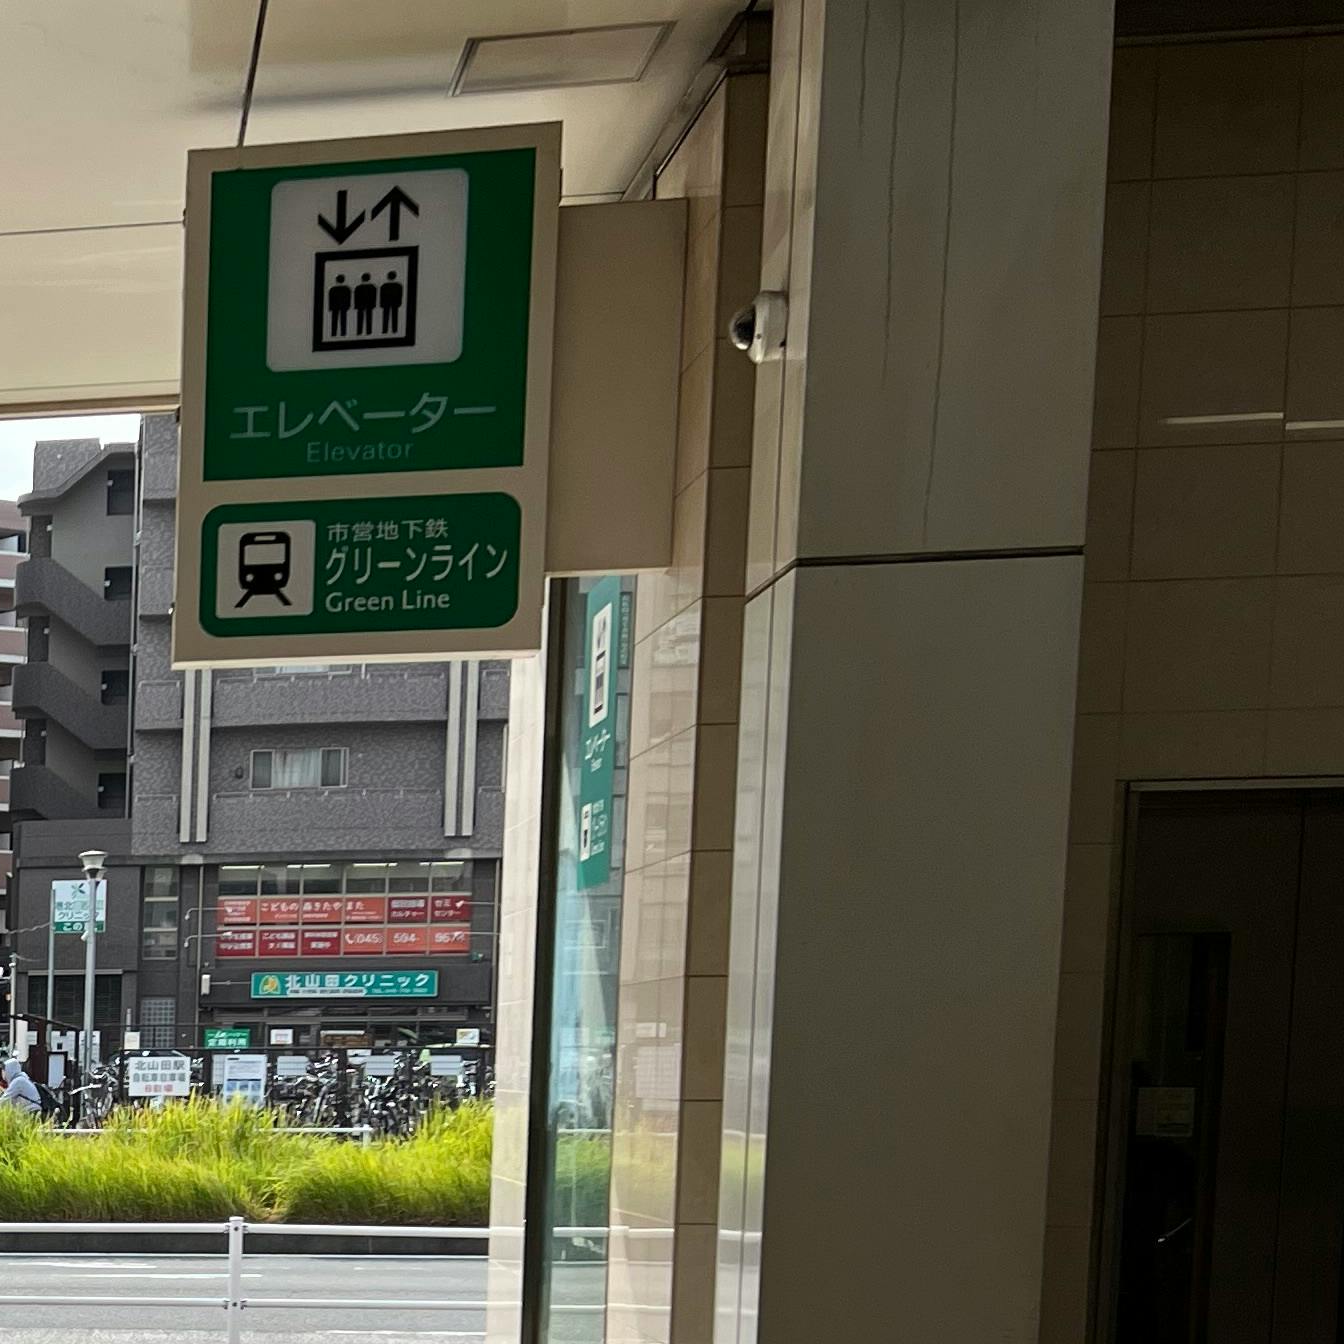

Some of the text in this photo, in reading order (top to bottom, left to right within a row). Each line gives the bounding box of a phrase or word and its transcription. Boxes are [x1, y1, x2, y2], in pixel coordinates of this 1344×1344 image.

[229, 392, 496, 440] エレベーター
[305, 441, 414, 464] Elevator
[326, 517, 449, 543] 市営地下鉄
[325, 543, 509, 586] グリーンライン
[324, 590, 451, 613] Green Line
[285, 973, 430, 988] 北山田クリニック
[134, 1060, 185, 1071] 北山田駅
